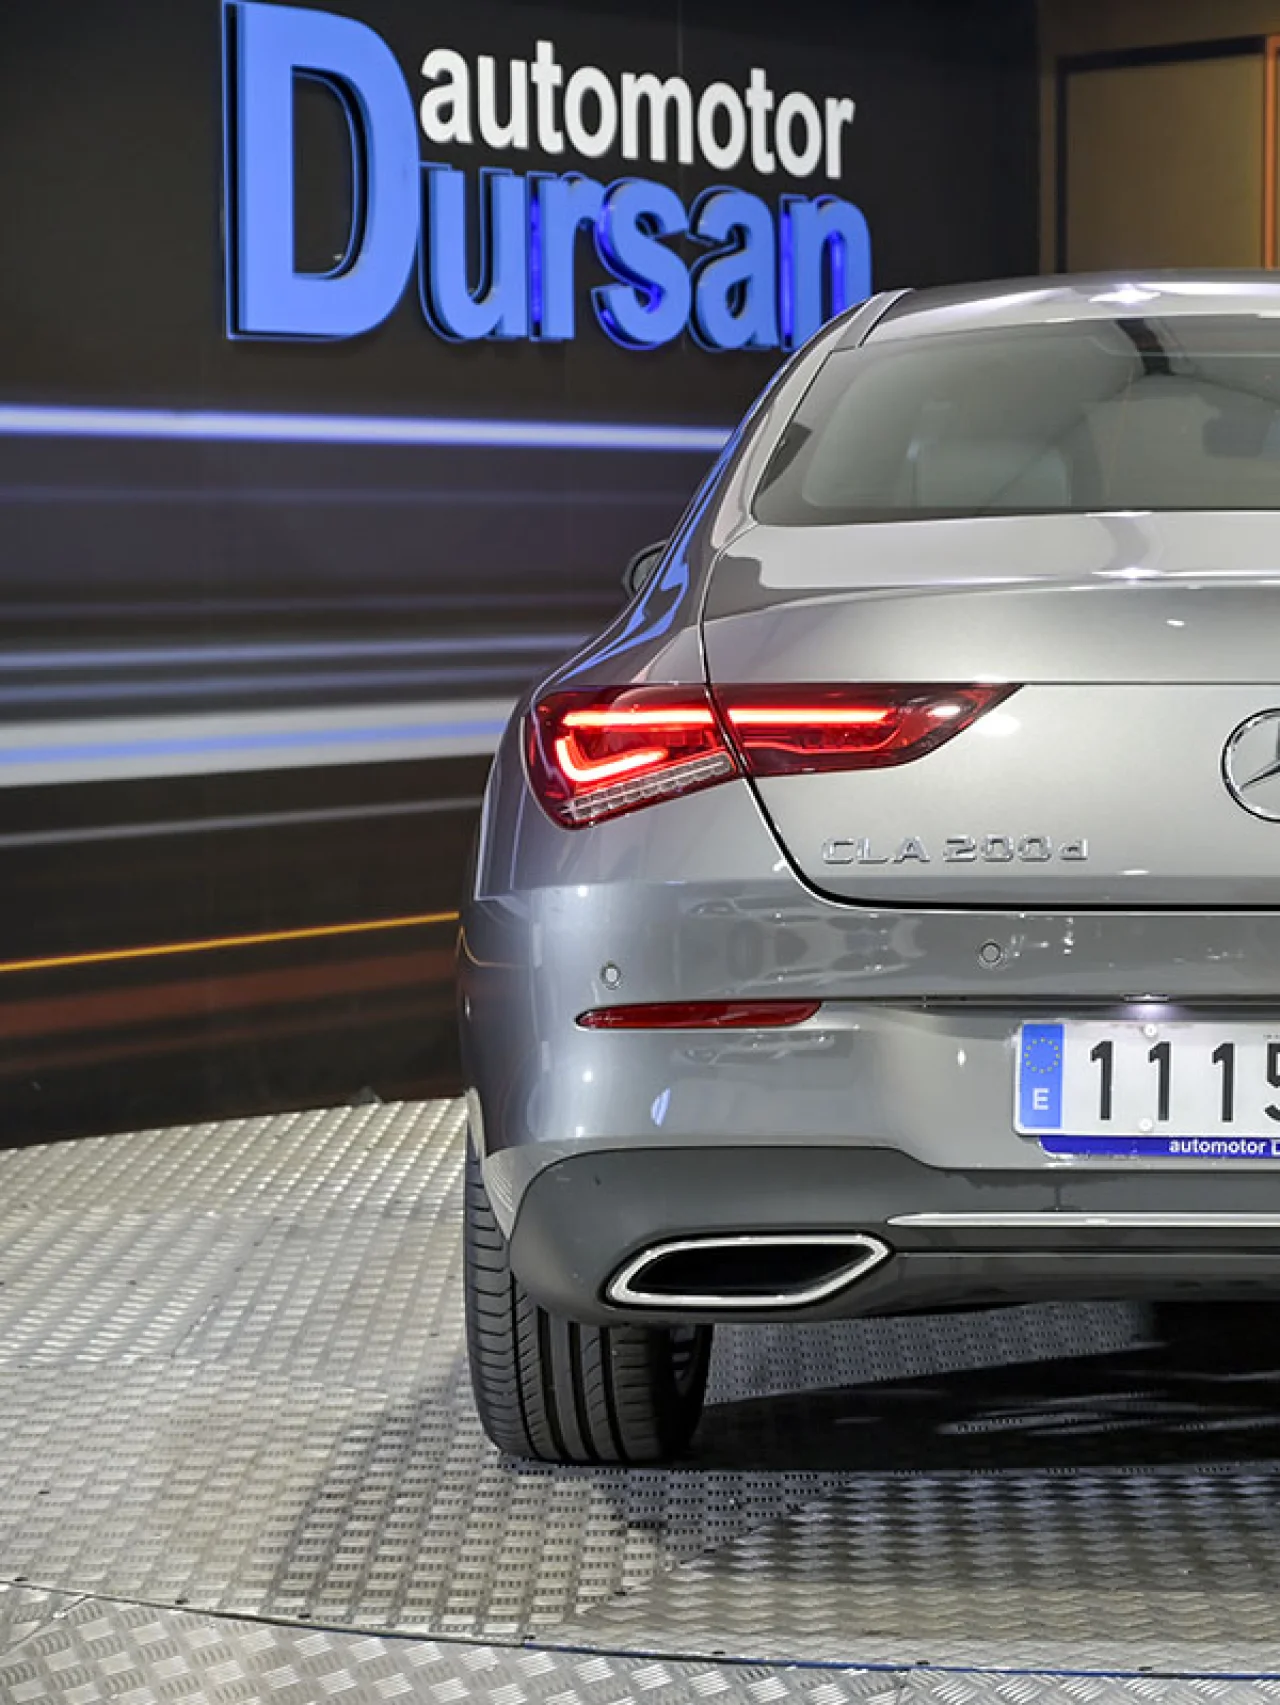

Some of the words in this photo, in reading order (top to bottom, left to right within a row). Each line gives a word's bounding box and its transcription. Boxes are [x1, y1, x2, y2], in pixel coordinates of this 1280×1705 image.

[420, 40, 855, 179] automotor
[222, 0, 872, 351] Dursan
[821, 836, 931, 865] CLA
[1031, 1088, 1050, 1111] E
[1169, 1138, 1267, 1155] automotor
